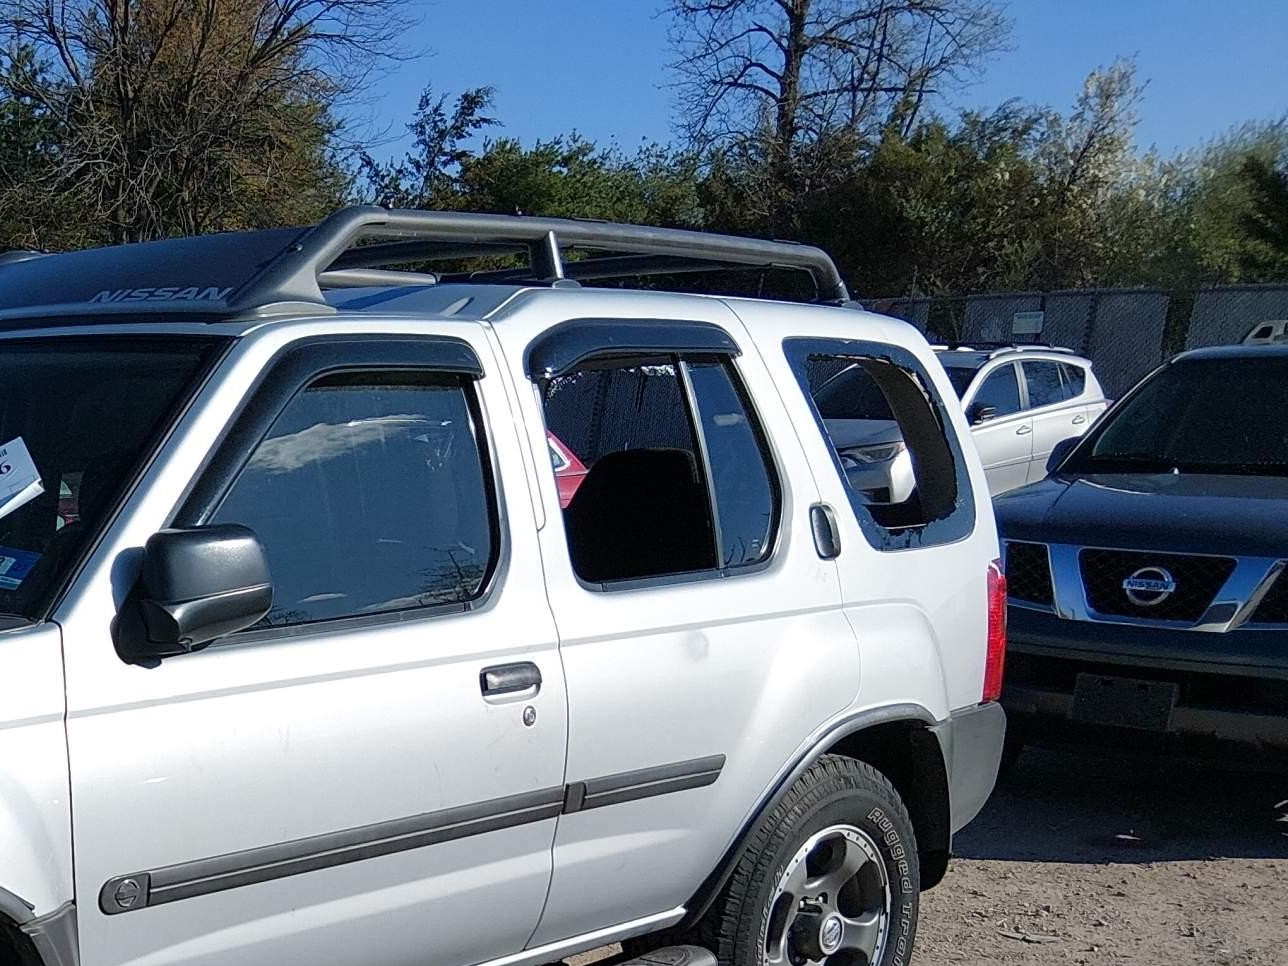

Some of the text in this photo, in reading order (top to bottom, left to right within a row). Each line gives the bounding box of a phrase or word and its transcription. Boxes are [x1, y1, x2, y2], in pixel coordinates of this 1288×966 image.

[87, 286, 234, 304] NISSAN
[1126, 580, 1170, 591] NISSAN
[866, 807, 913, 894] Rugged
